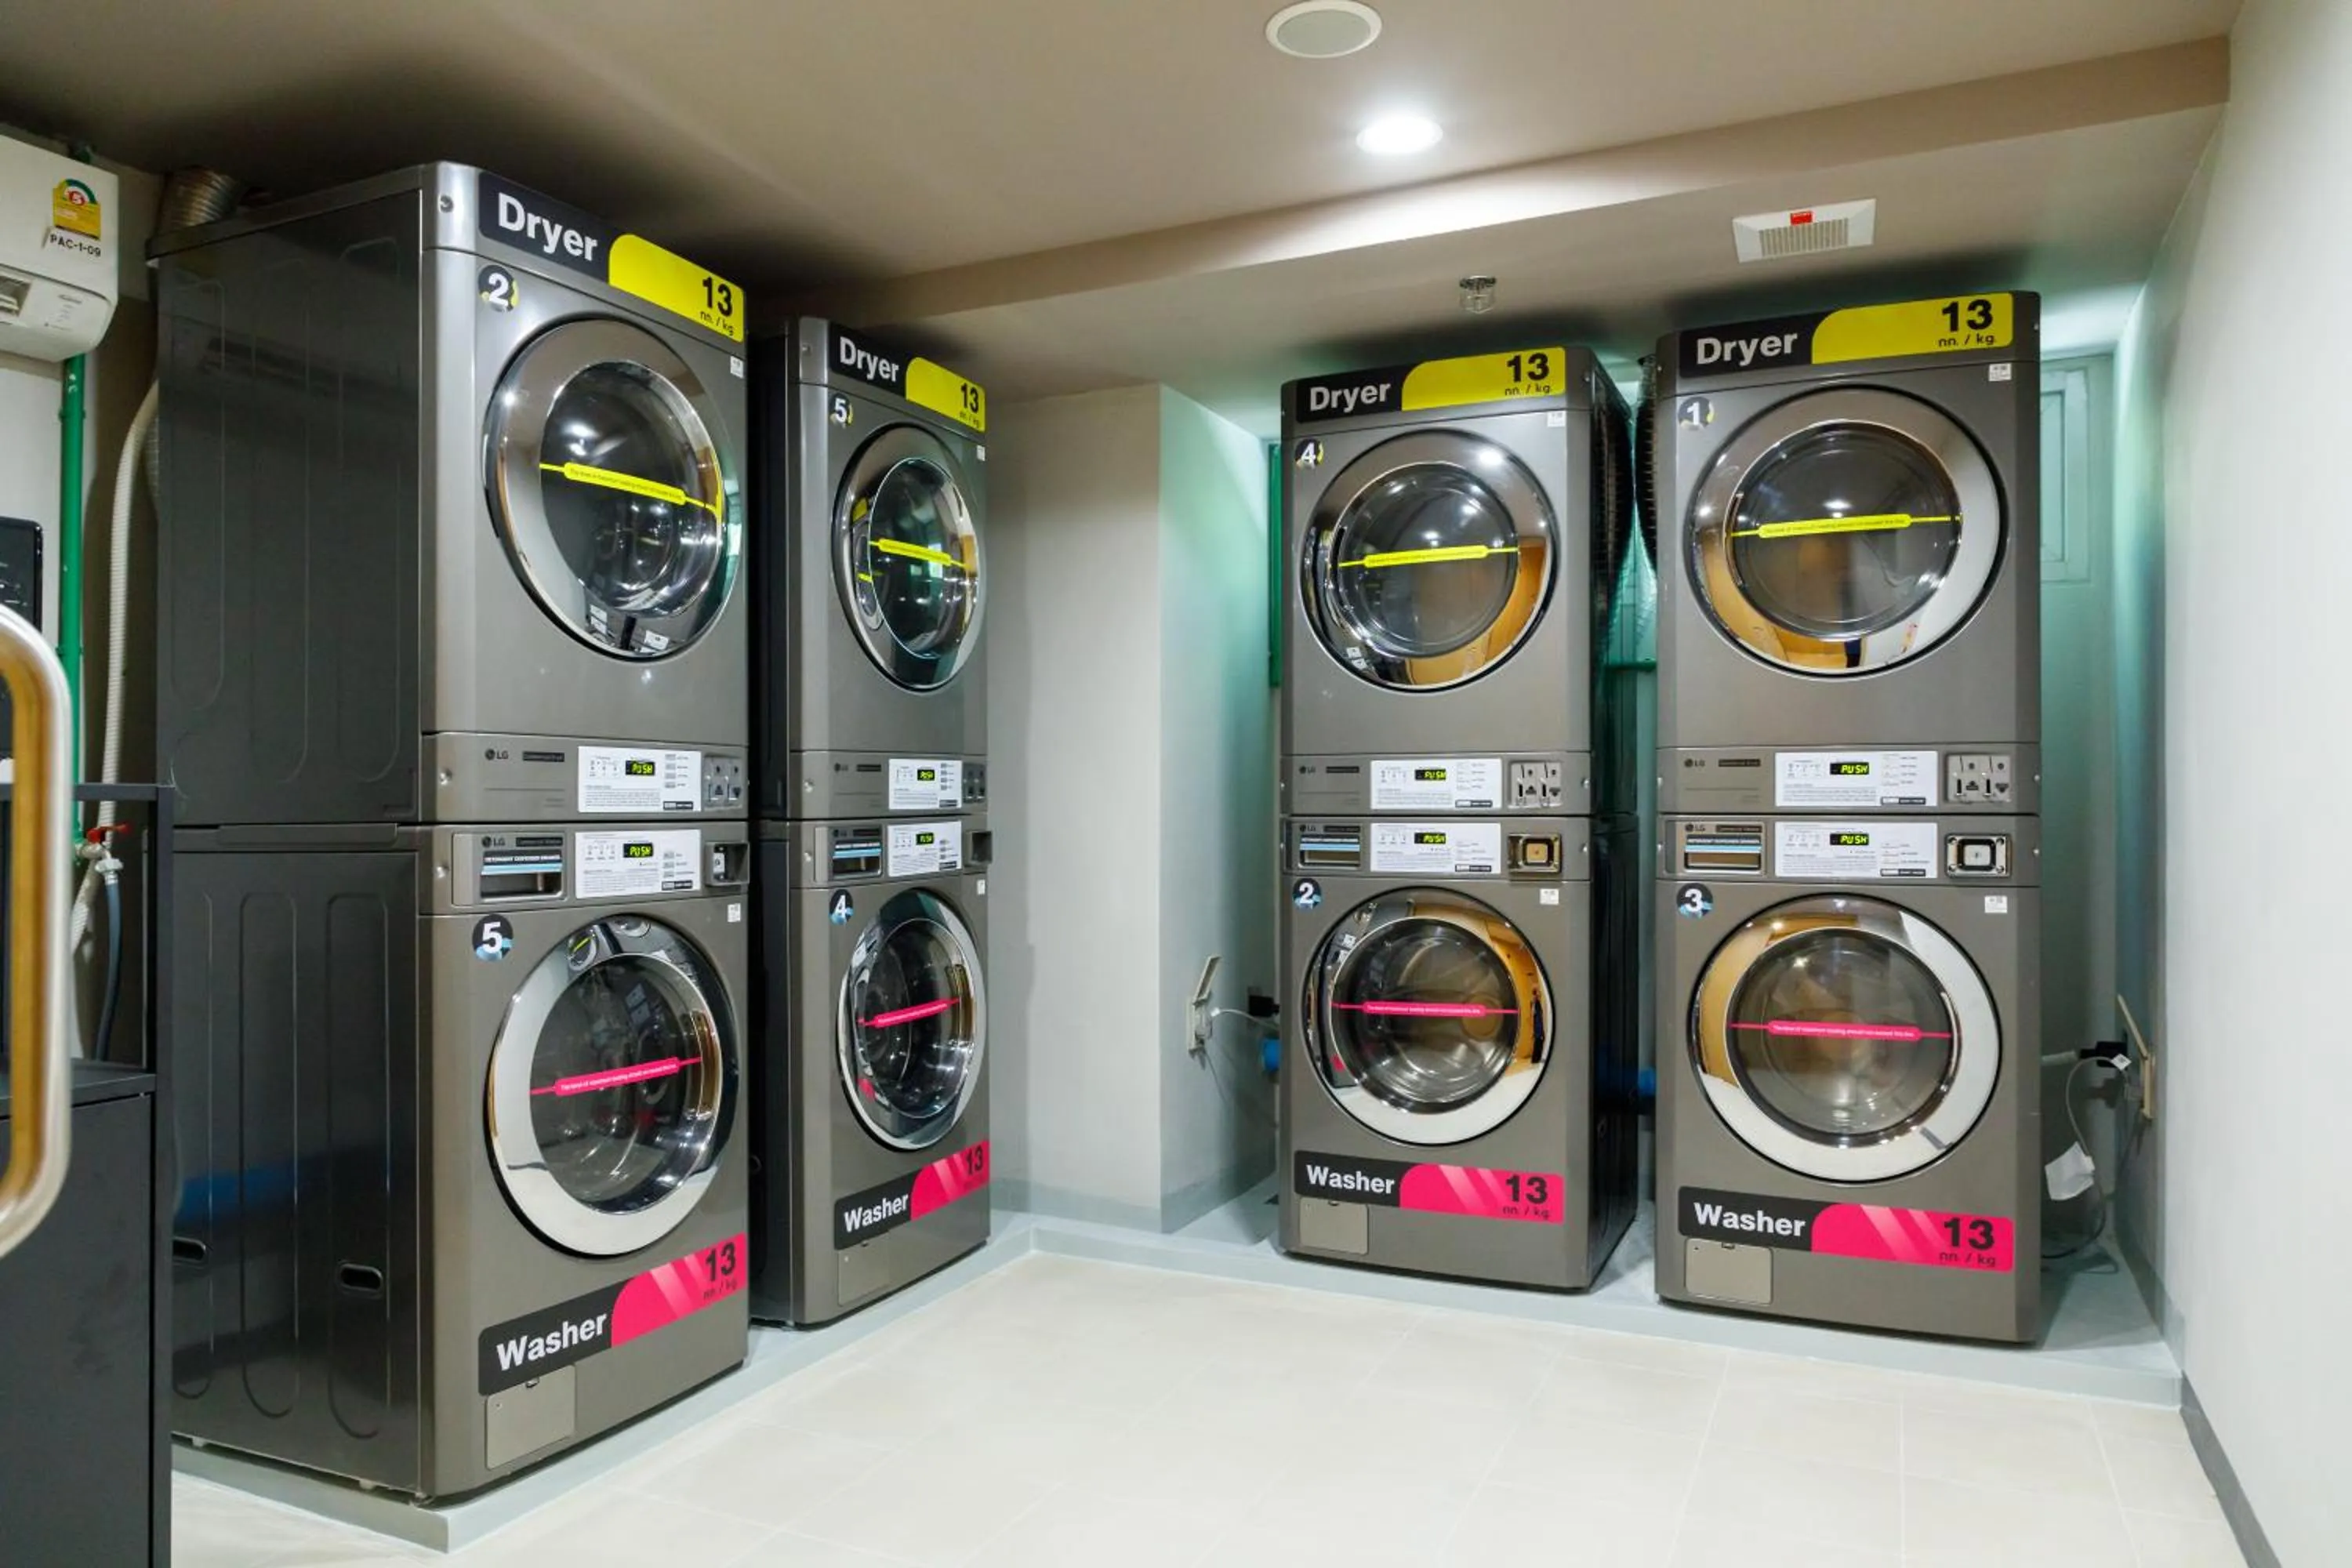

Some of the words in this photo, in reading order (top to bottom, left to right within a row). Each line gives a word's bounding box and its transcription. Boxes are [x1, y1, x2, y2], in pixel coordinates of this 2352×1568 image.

[498, 192, 598, 261] Dryer
[49, 234, 101, 256] PAC-1-09
[488, 272, 509, 307] 2
[702, 276, 733, 318] 13
[722, 318, 735, 336] kg
[1941, 299, 1994, 332] 13
[1696, 332, 1798, 367] Dryer
[1976, 332, 1995, 346] kg
[840, 336, 900, 383] Dryer
[1506, 352, 1550, 383] 13
[960, 382, 979, 414] 13
[1309, 382, 1392, 413] Dryer
[1535, 383, 1551, 394] kg
[833, 397, 848, 423] 5
[1686, 402, 1700, 426] 1
[1301, 441, 1317, 463] 4
[496, 750, 510, 760] LG
[1840, 764, 1869, 774] PUSH
[492, 837, 506, 847] LG
[630, 846, 652, 856] PUSH
[1839, 835, 1868, 844] PUSH
[834, 895, 848, 916] 4
[1298, 882, 1314, 902] 2
[1683, 887, 1704, 913] 3
[481, 921, 505, 954] 5
[965, 1145, 983, 1175] 13
[1306, 1164, 1395, 1194] Washer
[1505, 1174, 1548, 1204] 13
[844, 1193, 909, 1233] Washer
[1534, 1207, 1550, 1221] kg
[1693, 1202, 1806, 1237] Washer
[1944, 1217, 1995, 1250] 13
[706, 1241, 736, 1282] 13
[1977, 1254, 1995, 1268] kg
[496, 1312, 608, 1371] Washer
